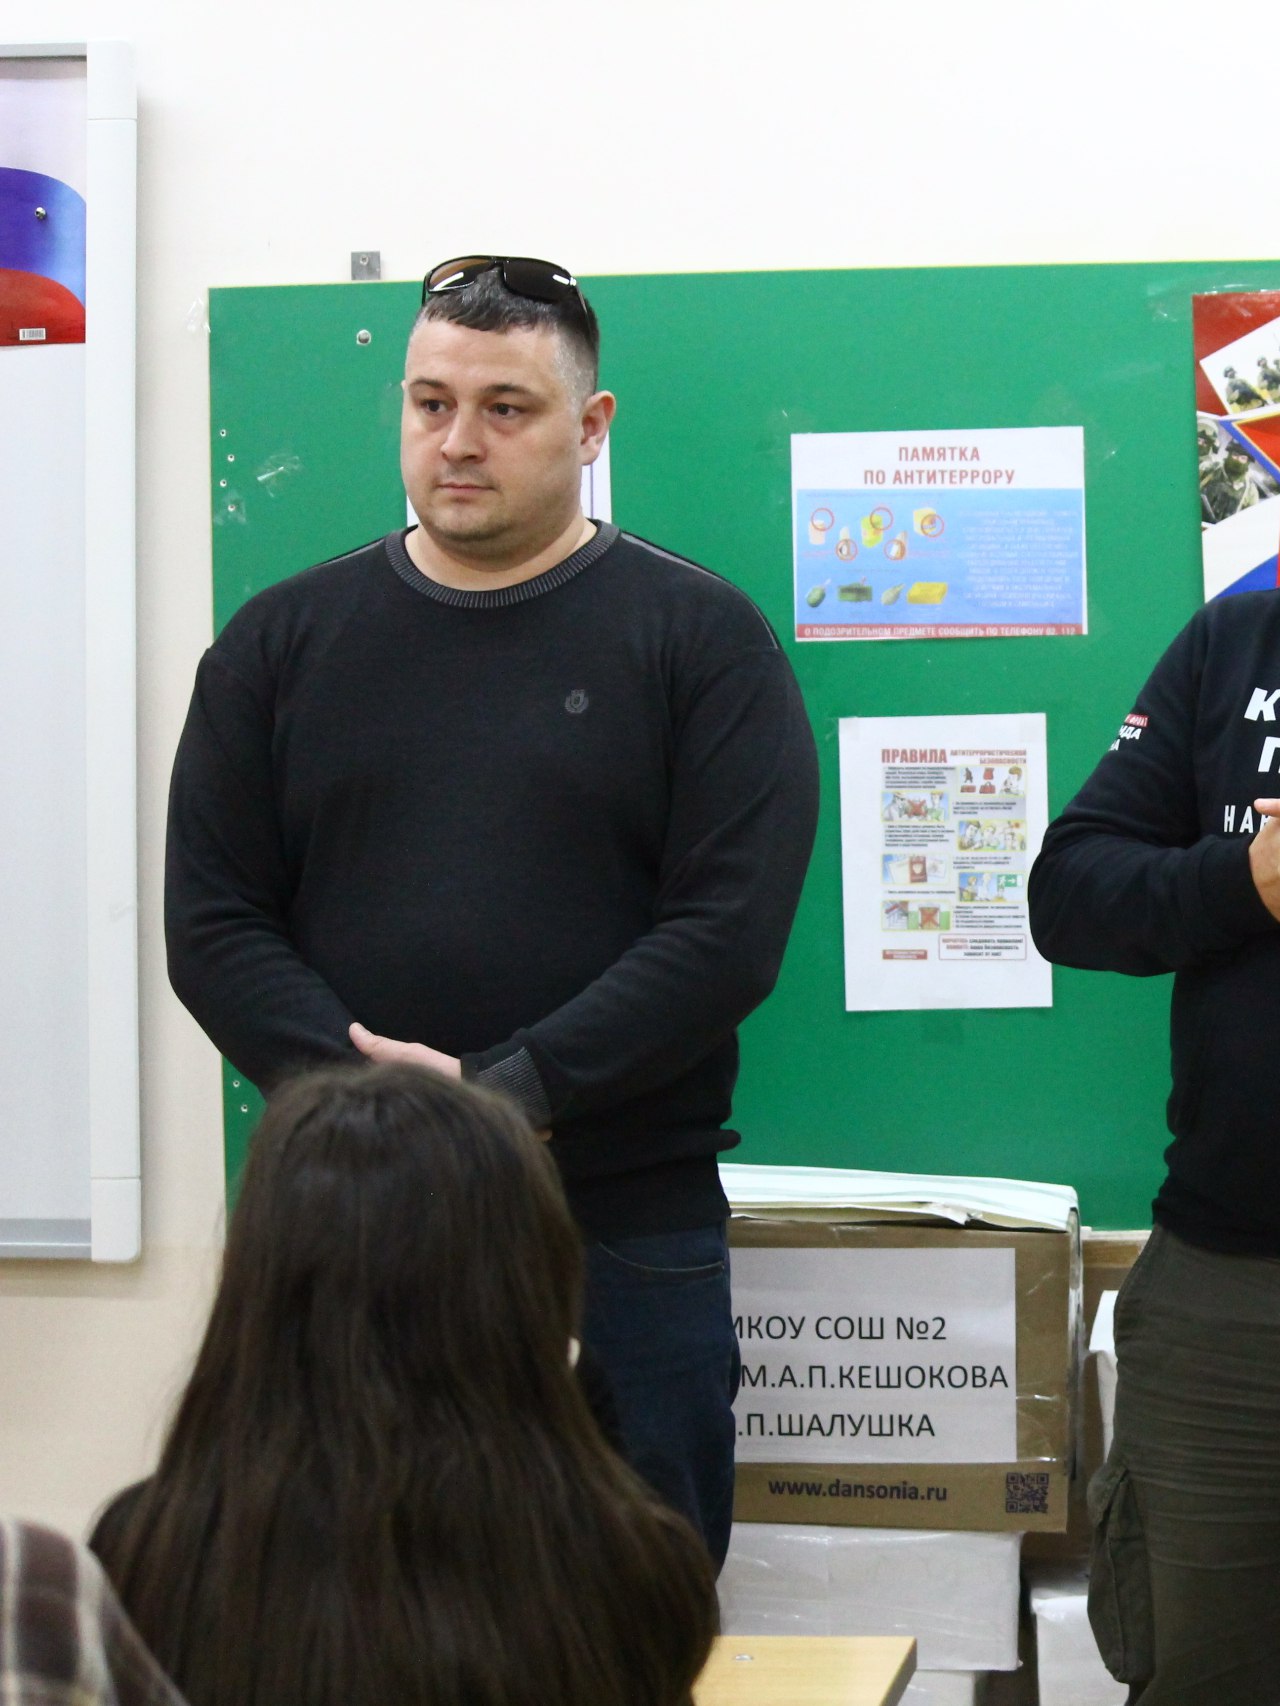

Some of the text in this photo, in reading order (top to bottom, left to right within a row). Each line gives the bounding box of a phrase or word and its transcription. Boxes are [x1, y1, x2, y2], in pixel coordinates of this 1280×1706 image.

[898, 446, 981, 462] ПАМЯТКА
[864, 468, 1015, 485] ПО АНТИТЕРРОРУ
[893, 627, 936, 636] ПРЕДМЕТЕ
[881, 748, 948, 763] ПРАВИЛА
[814, 1314, 885, 1340] СОШ
[895, 1315, 948, 1340] №2
[741, 1363, 1009, 1389] М.А.П.КЕШОКОВА
[738, 1412, 936, 1438] .П.ШАЛУШКА
[768, 1478, 948, 1503] www.dansonia.ru
